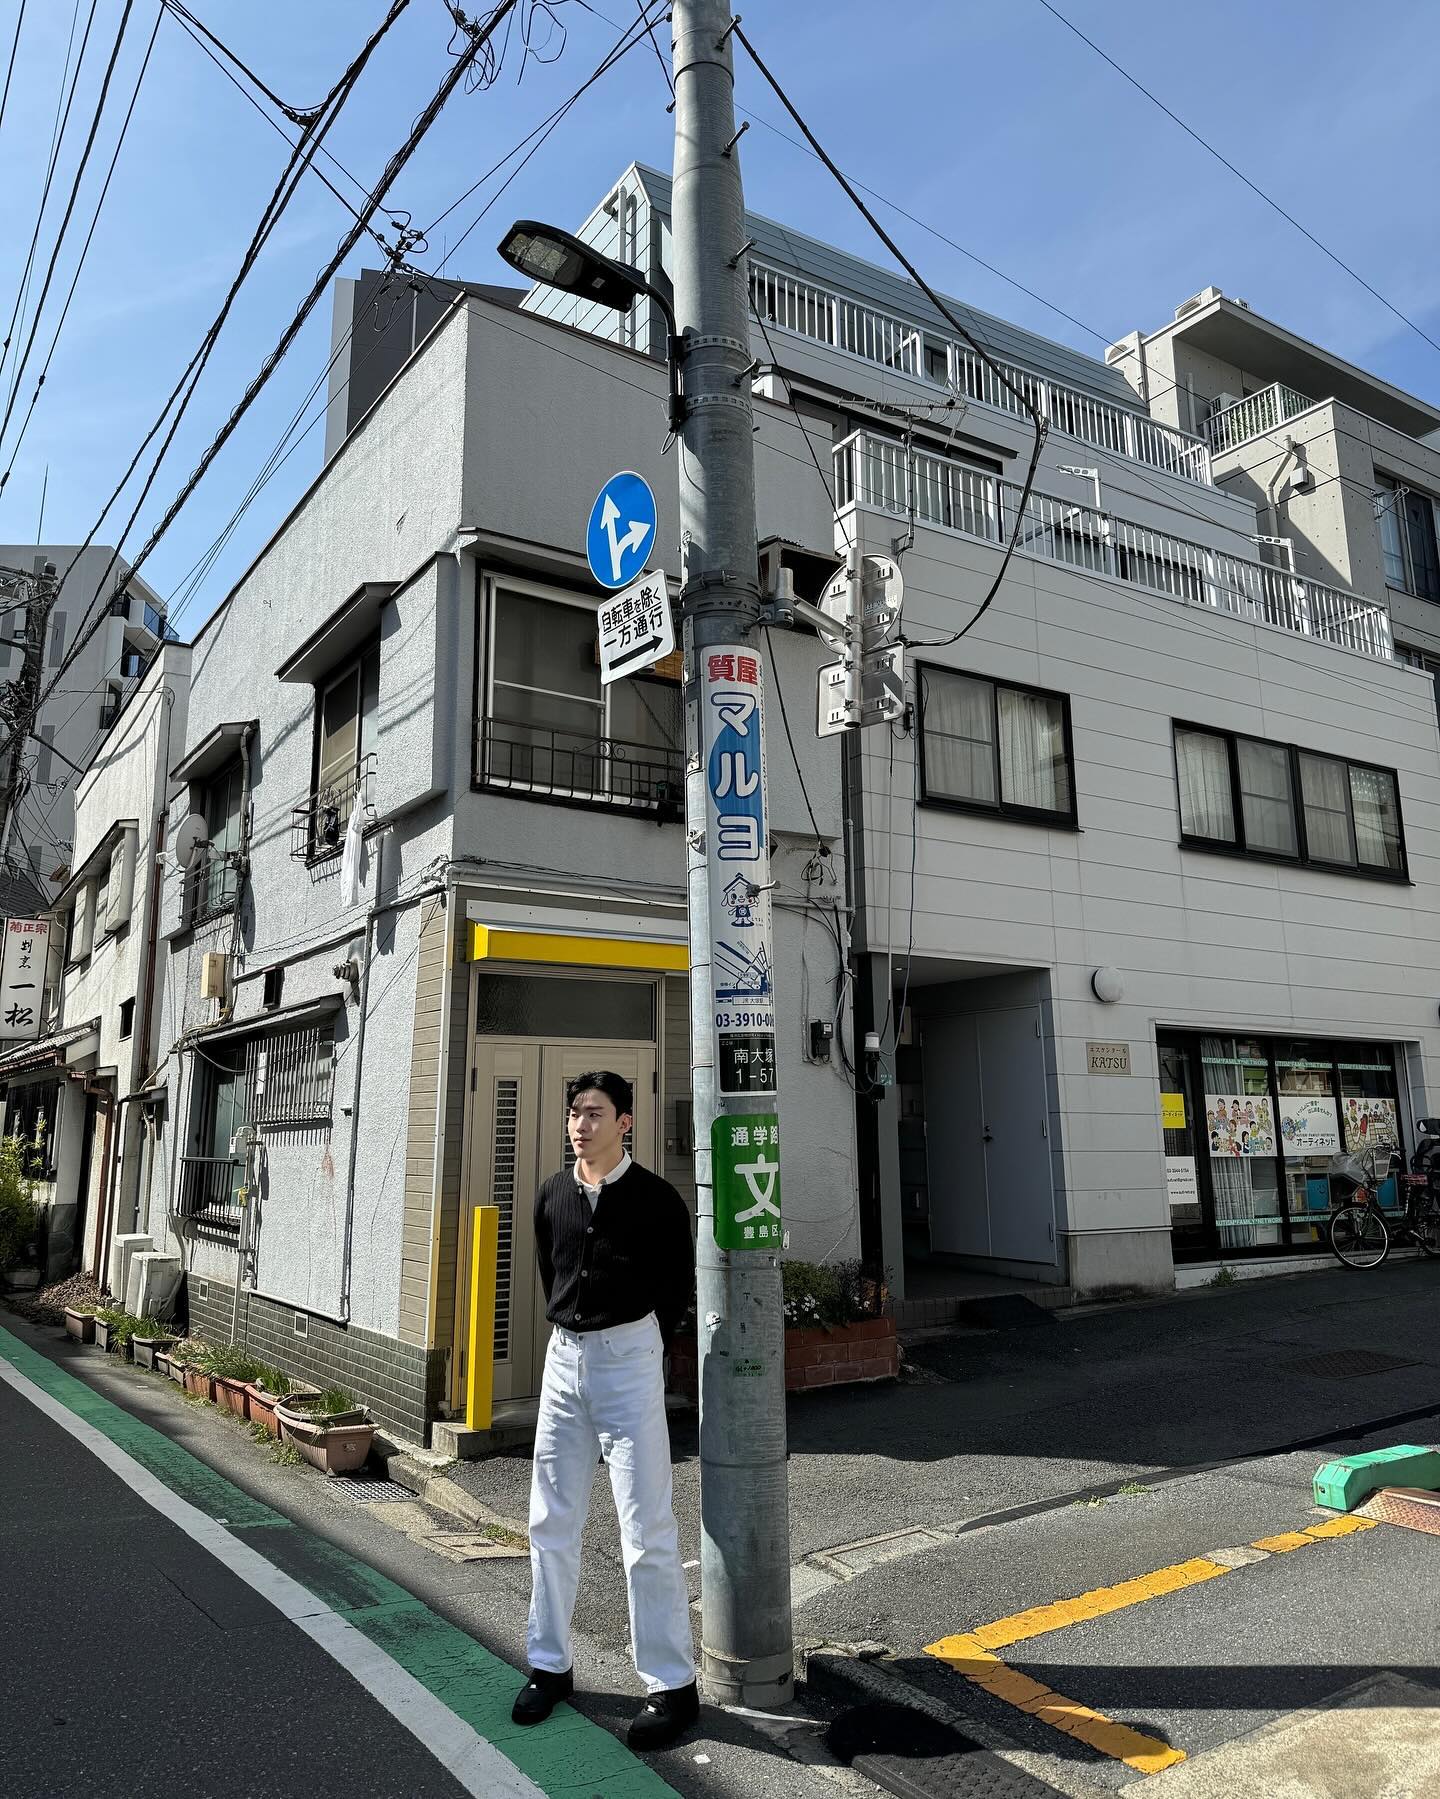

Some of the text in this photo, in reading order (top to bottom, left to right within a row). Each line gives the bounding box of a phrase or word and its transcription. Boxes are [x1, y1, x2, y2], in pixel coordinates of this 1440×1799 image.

[602, 586, 661, 632] 自転車を除く
[604, 605, 664, 648] 一方通行
[707, 654, 758, 686] 質屋
[711, 691, 760, 862] マルヨ
[9, 921, 48, 935] 菊正宗
[4, 983, 36, 1027] 一松
[733, 1047, 774, 1065] 南大塚
[1091, 1056, 1127, 1069] KATSU
[731, 1125, 778, 1147] 通学路
[1296, 1137, 1336, 1147] オーティネット
[734, 1153, 781, 1223] 文
[744, 1224, 779, 1239] 豊島区
